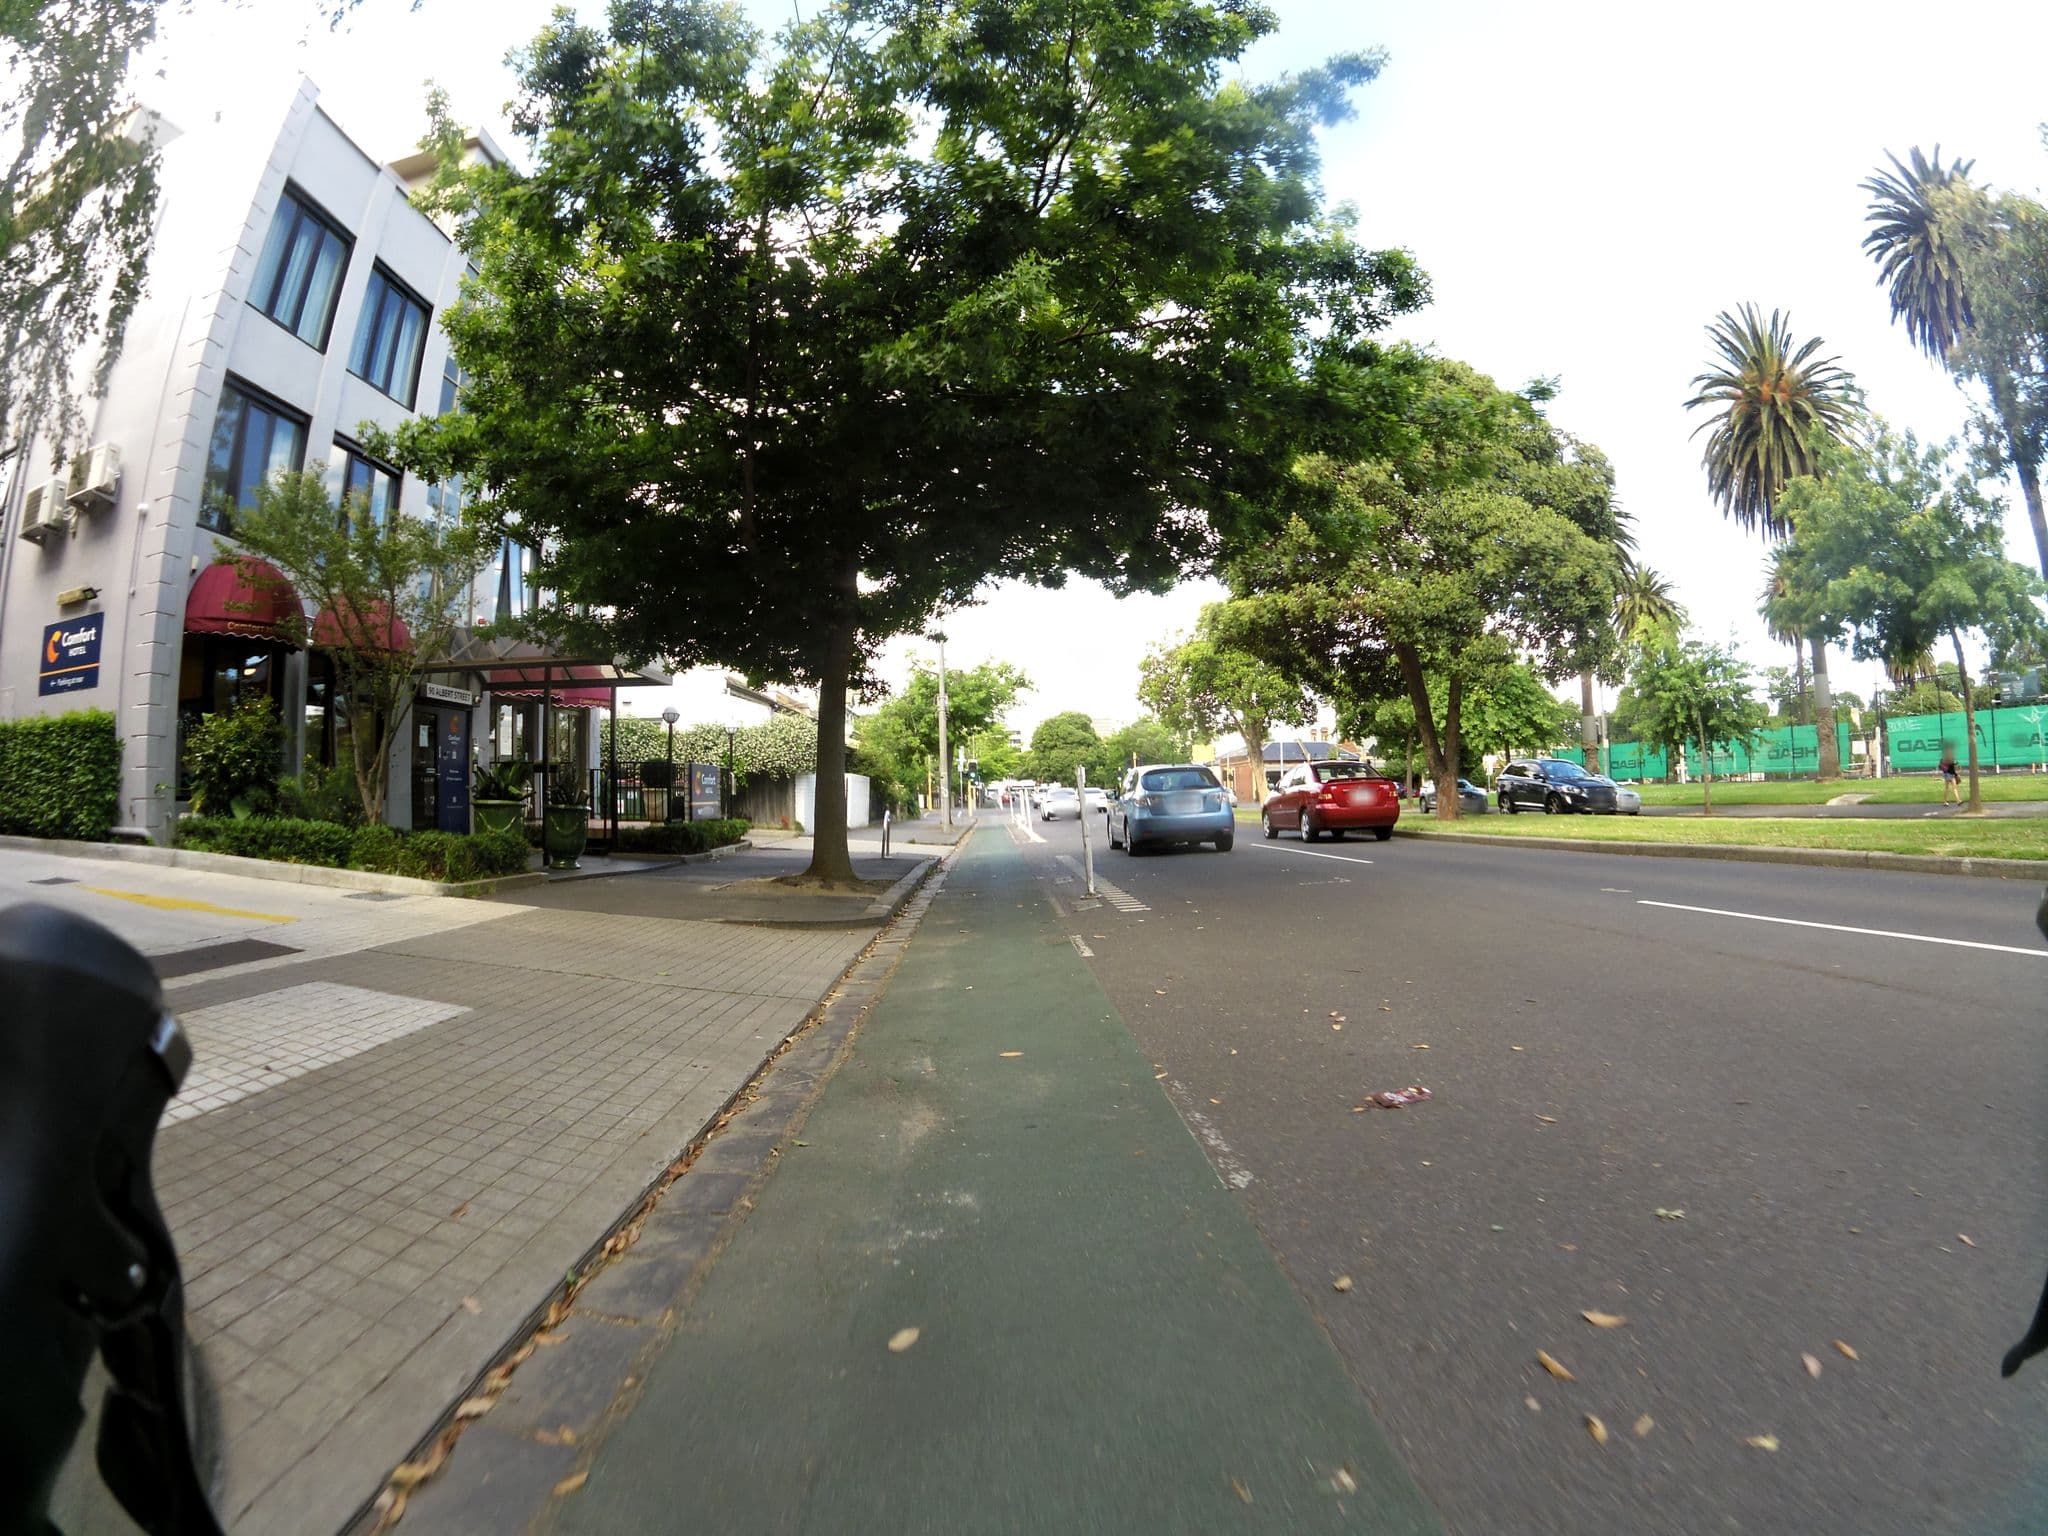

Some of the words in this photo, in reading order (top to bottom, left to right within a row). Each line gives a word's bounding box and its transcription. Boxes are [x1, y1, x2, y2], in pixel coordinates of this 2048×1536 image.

[63, 627, 96, 647] Comfort
[69, 646, 86, 656] HOTEL
[436, 688, 454, 697] ALBERT
[454, 691, 471, 702] STREET
